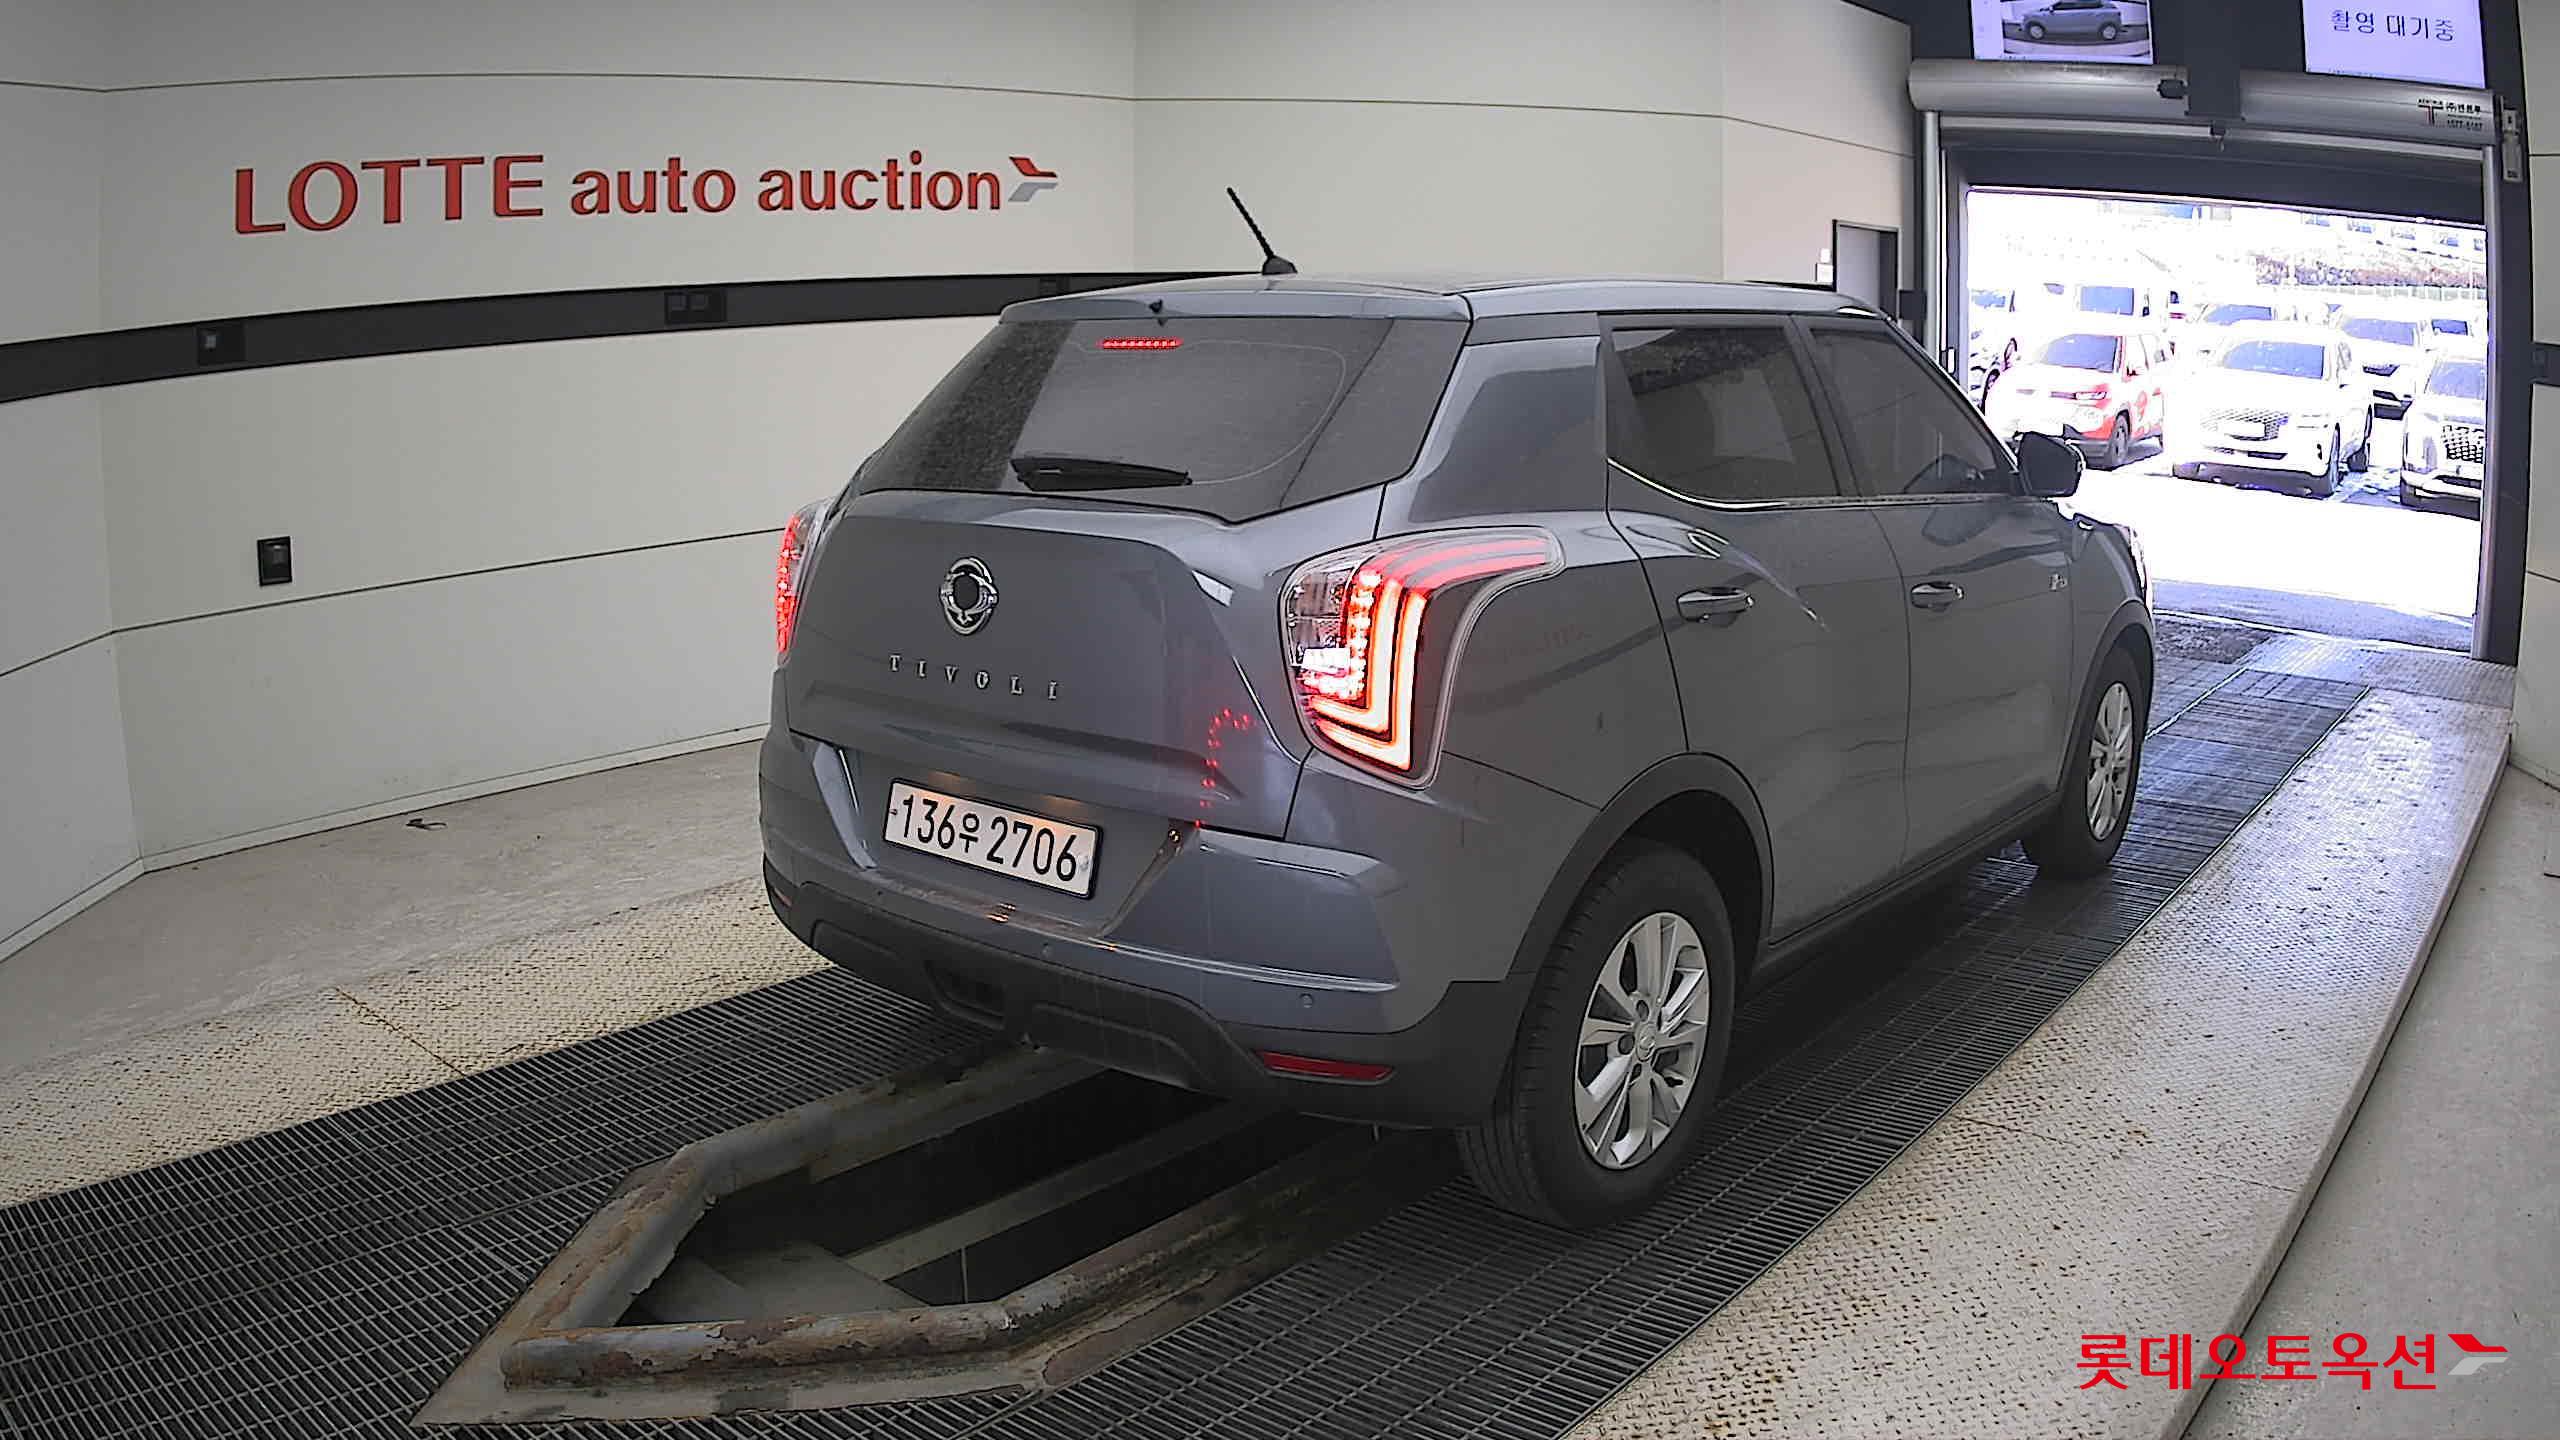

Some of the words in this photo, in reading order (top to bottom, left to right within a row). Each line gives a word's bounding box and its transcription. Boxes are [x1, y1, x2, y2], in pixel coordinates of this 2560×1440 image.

[2331, 10, 2375, 34] 촬영
[2386, 15, 2454, 42] 대기중
[235, 154, 544, 234] LOTTE
[571, 157, 736, 214] auto
[758, 150, 1001, 211] auction
[889, 653, 1058, 700] TIVOLI
